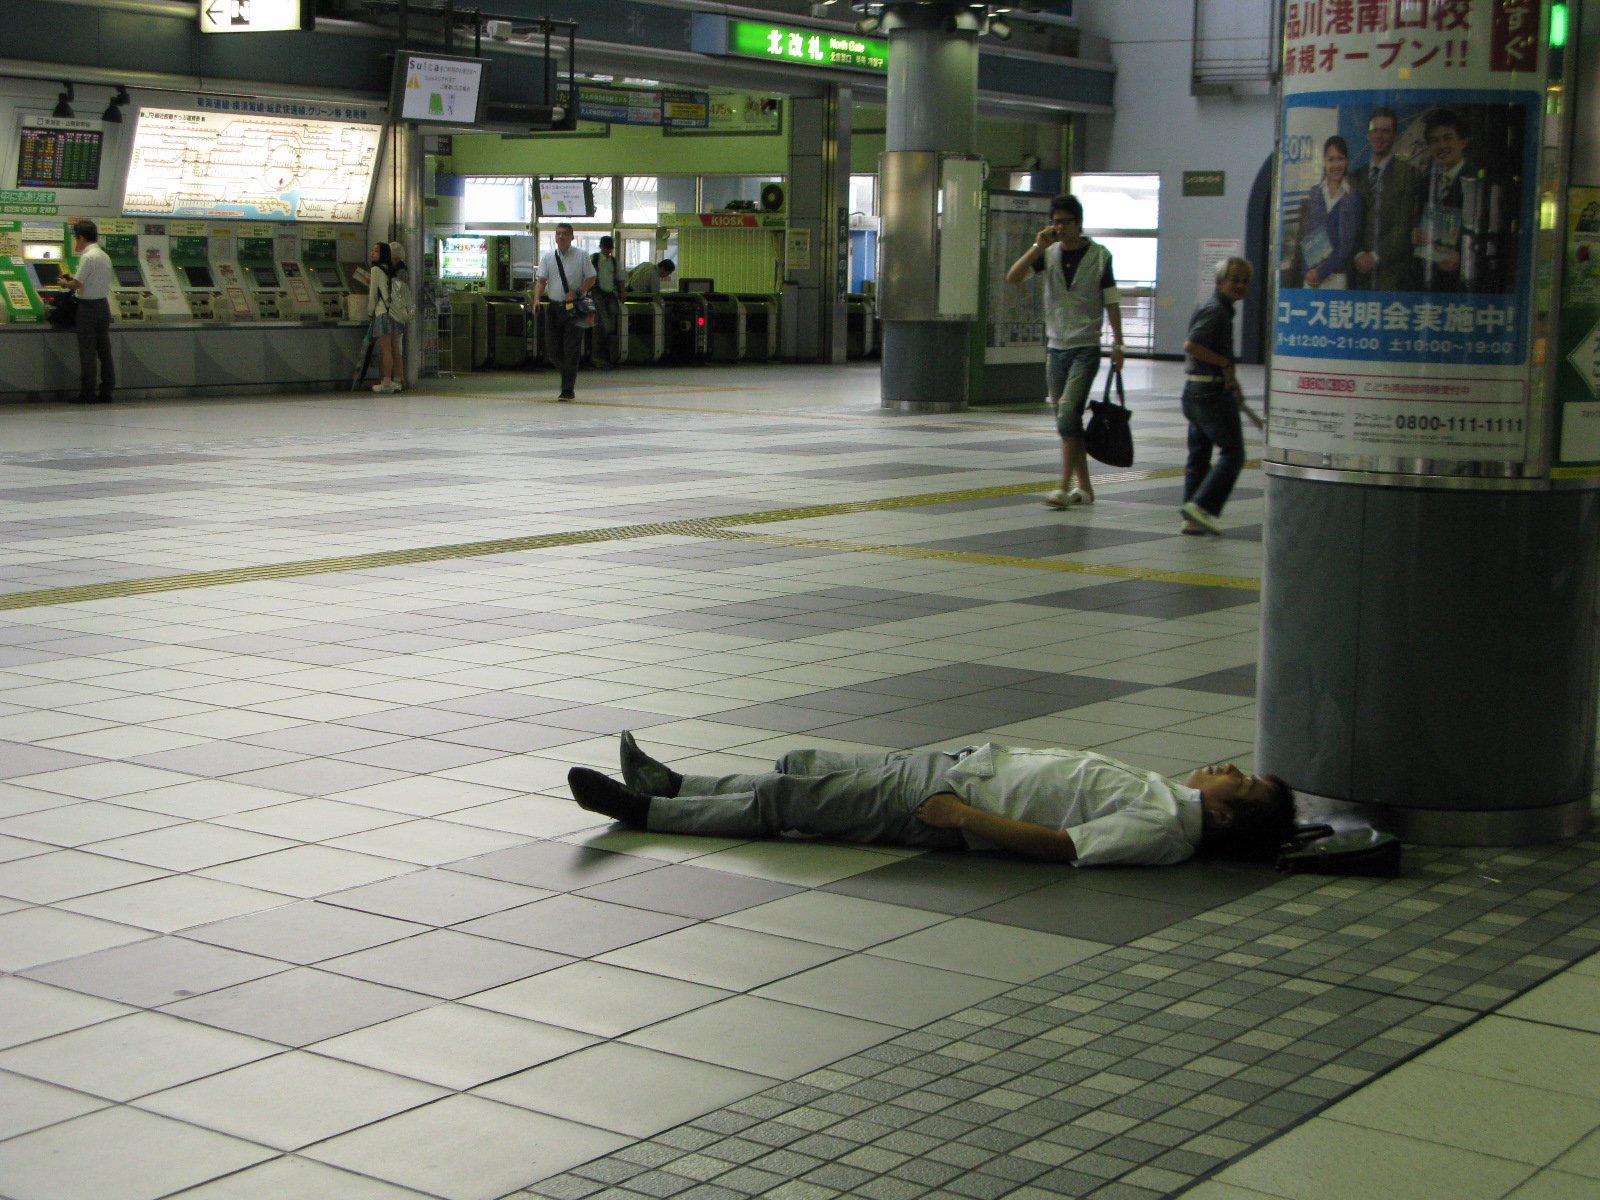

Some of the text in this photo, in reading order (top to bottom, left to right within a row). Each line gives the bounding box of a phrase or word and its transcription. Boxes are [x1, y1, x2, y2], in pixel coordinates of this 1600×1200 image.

[767, 29, 824, 61] 北改札
[829, 38, 865, 53] North Gate
[409, 60, 439, 72] Suica
[711, 215, 745, 226] KIOSK
[1278, 300, 1516, 333] コース説明会実施中!
[1395, 415, 1523, 433] 0800-111-1111
